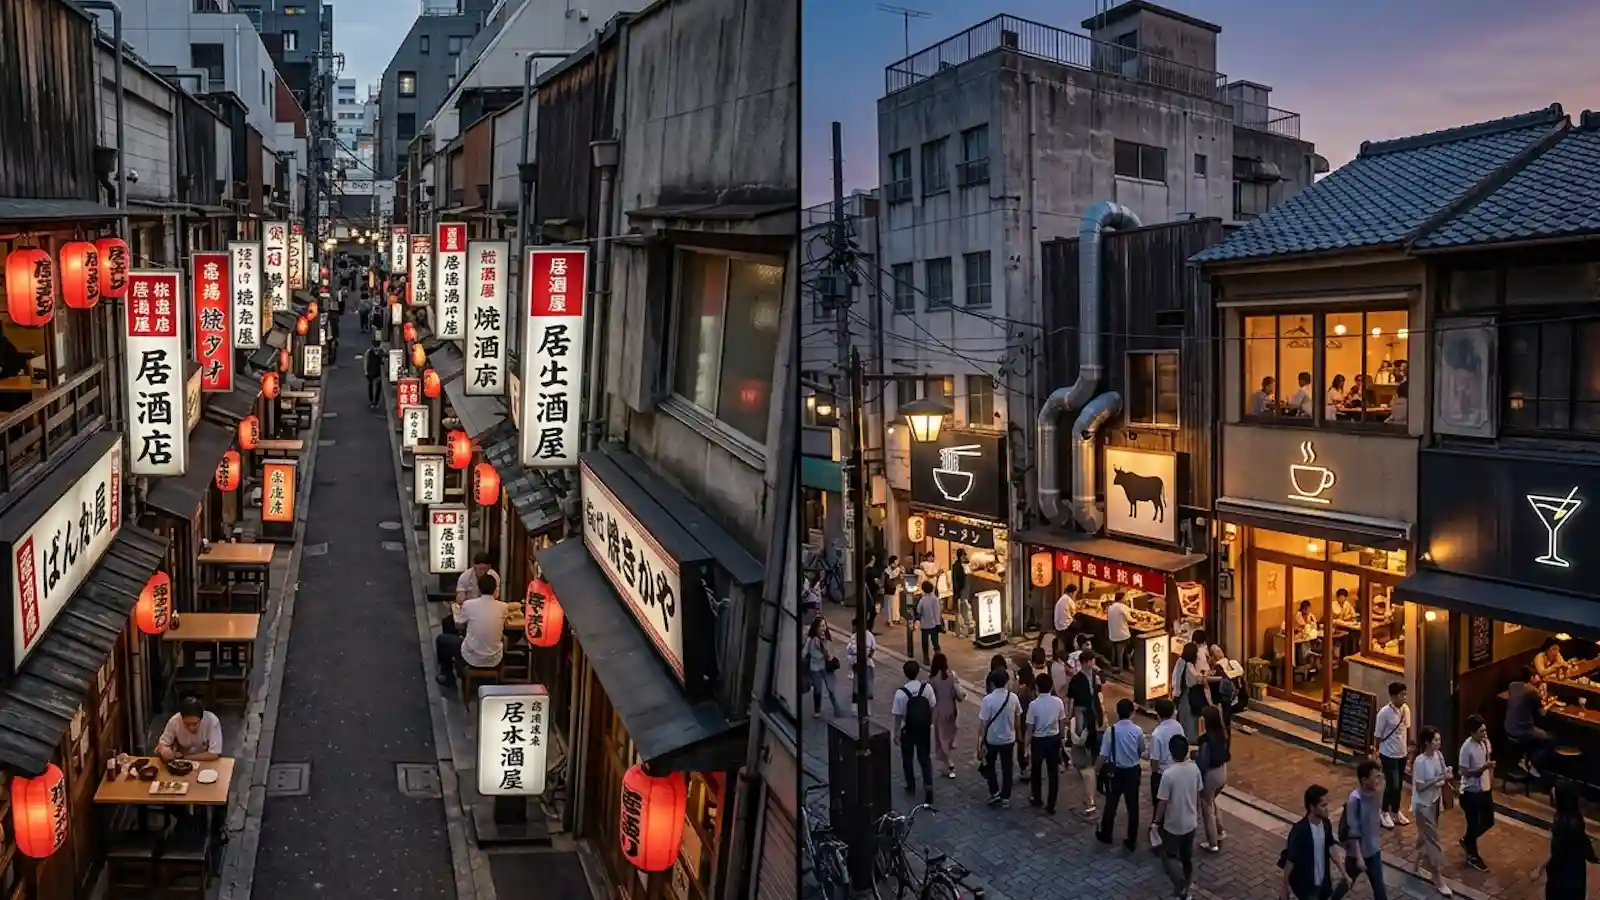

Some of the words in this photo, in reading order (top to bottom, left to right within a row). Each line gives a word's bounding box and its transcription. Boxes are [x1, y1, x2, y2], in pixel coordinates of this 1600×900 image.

[548, 257, 568, 312] 居酒屋
[135, 349, 172, 465] 居酒店
